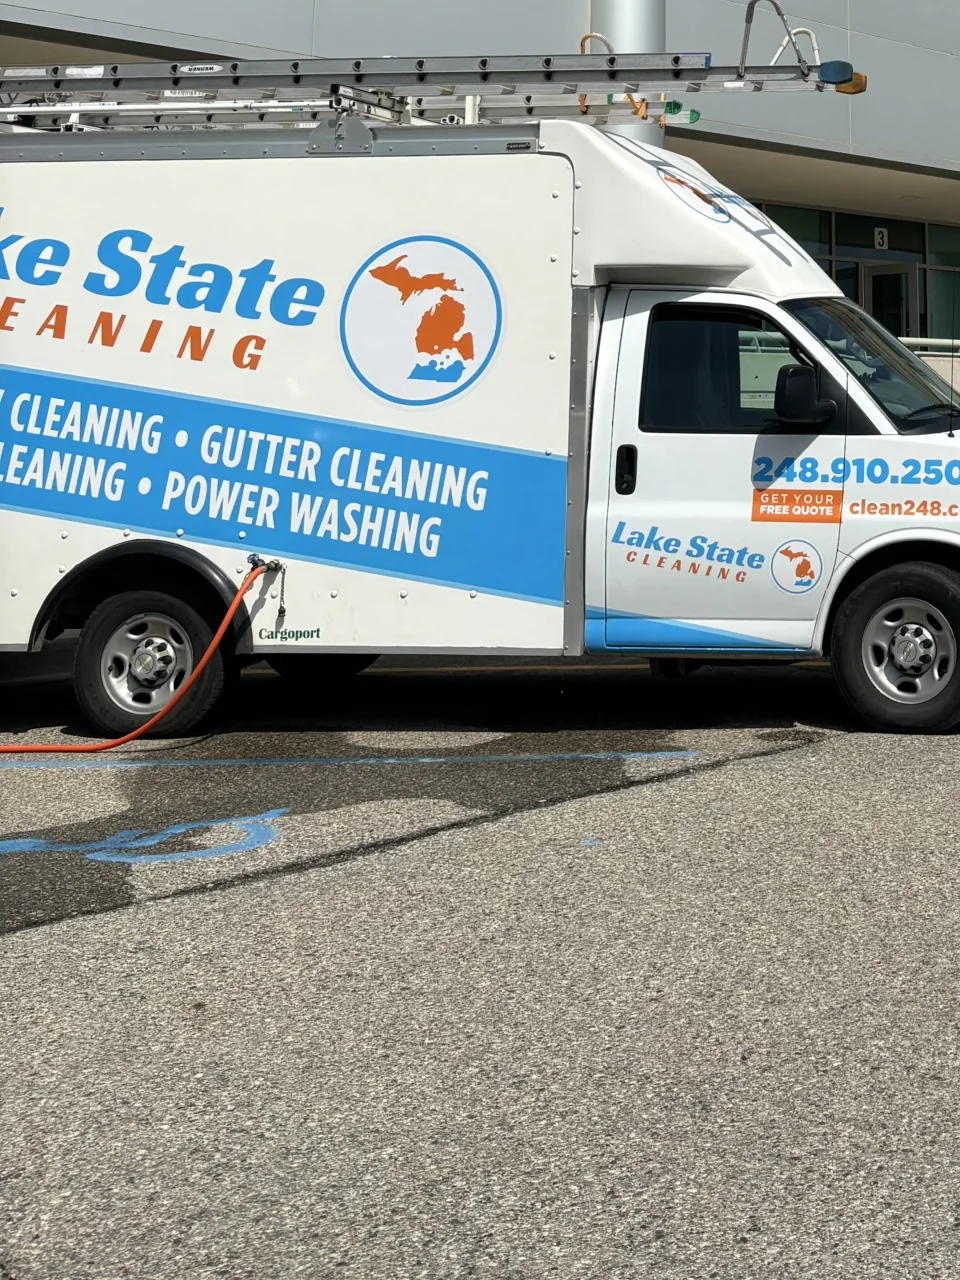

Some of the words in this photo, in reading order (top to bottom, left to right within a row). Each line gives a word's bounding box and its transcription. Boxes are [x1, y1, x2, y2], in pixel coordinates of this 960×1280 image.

[878, 230, 884, 247] 3
[83, 229, 325, 327] State
[10, 392, 164, 454] CLEANING
[201, 424, 321, 482] GUTTER
[330, 446, 489, 511] CLEANING
[162, 470, 280, 529] POWER
[290, 492, 442, 558] WASHING
[760, 505, 789, 515] FREE
[792, 506, 833, 516] QUOTE
[761, 493, 788, 504] GET
[794, 494, 834, 504] YOUR
[611, 521, 681, 554] Lake
[686, 535, 765, 569] State
[626, 551, 746, 583] CLEANING
[259, 628, 320, 641] Cargoport
